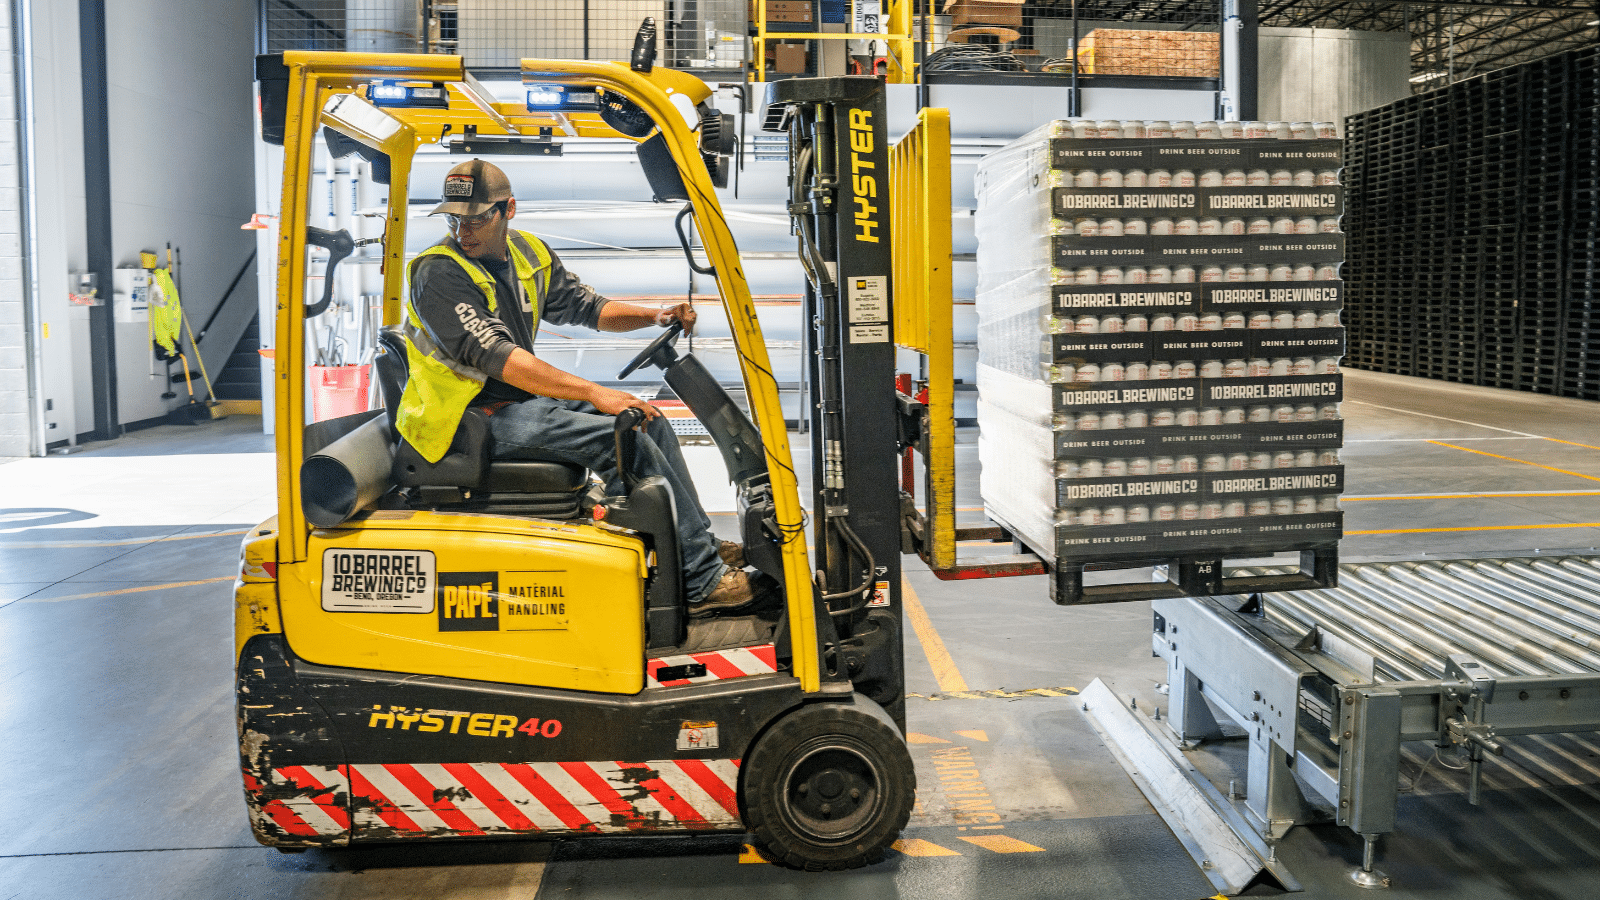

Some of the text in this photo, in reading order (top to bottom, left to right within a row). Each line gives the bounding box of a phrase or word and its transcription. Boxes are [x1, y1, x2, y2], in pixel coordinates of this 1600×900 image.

[849, 108, 879, 243] HYSTER
[332, 575, 404, 593] BREWING
[508, 586, 565, 598] MATERIAL
[508, 603, 566, 616] HANDLING
[368, 704, 562, 739] HYSTER 40
